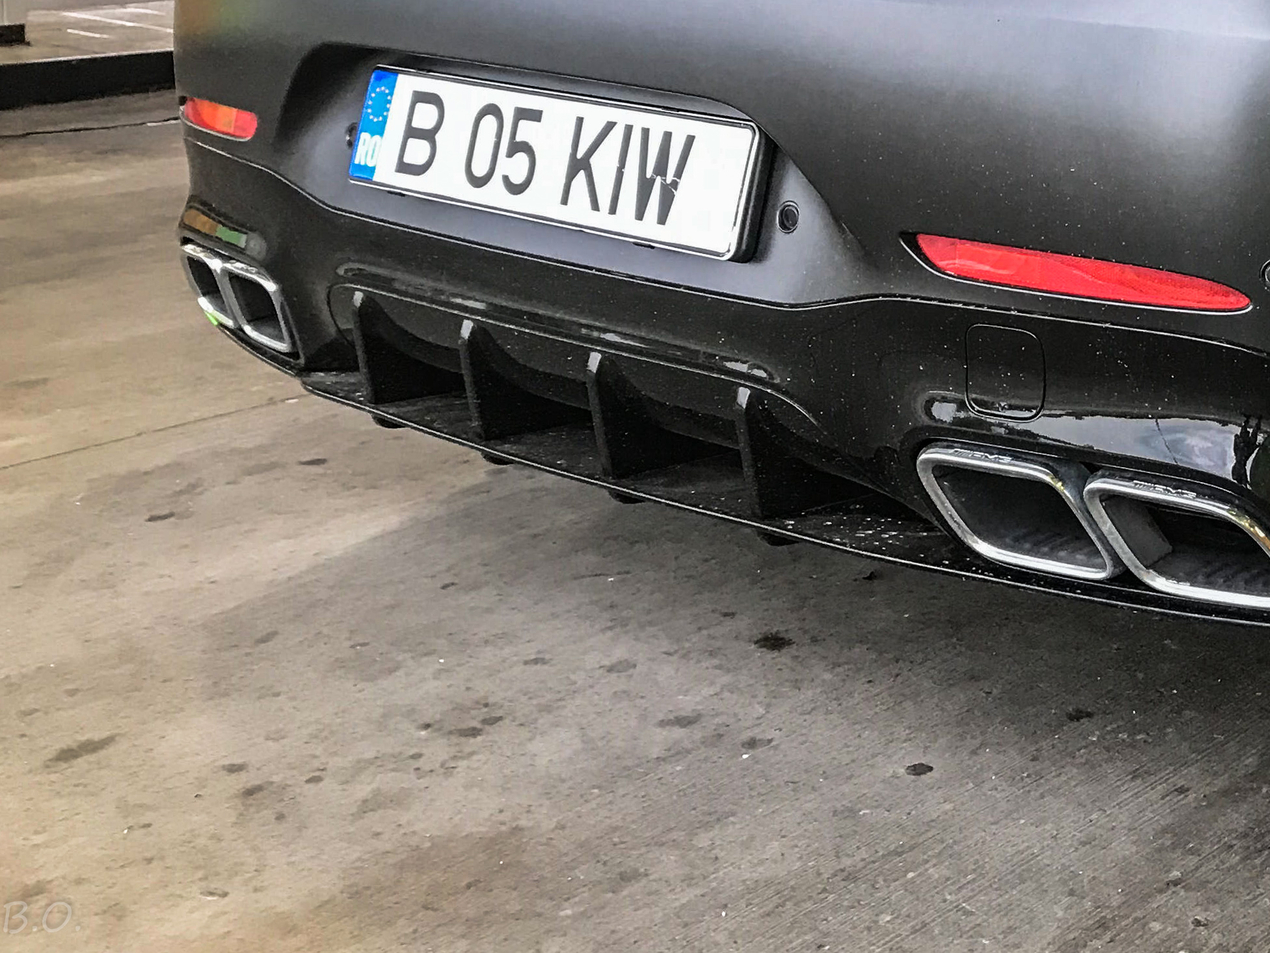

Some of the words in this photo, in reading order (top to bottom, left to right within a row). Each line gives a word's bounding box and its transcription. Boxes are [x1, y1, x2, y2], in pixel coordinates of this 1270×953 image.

[394, 90, 445, 177] B
[465, 102, 544, 196] 05
[559, 115, 696, 227] KIW
